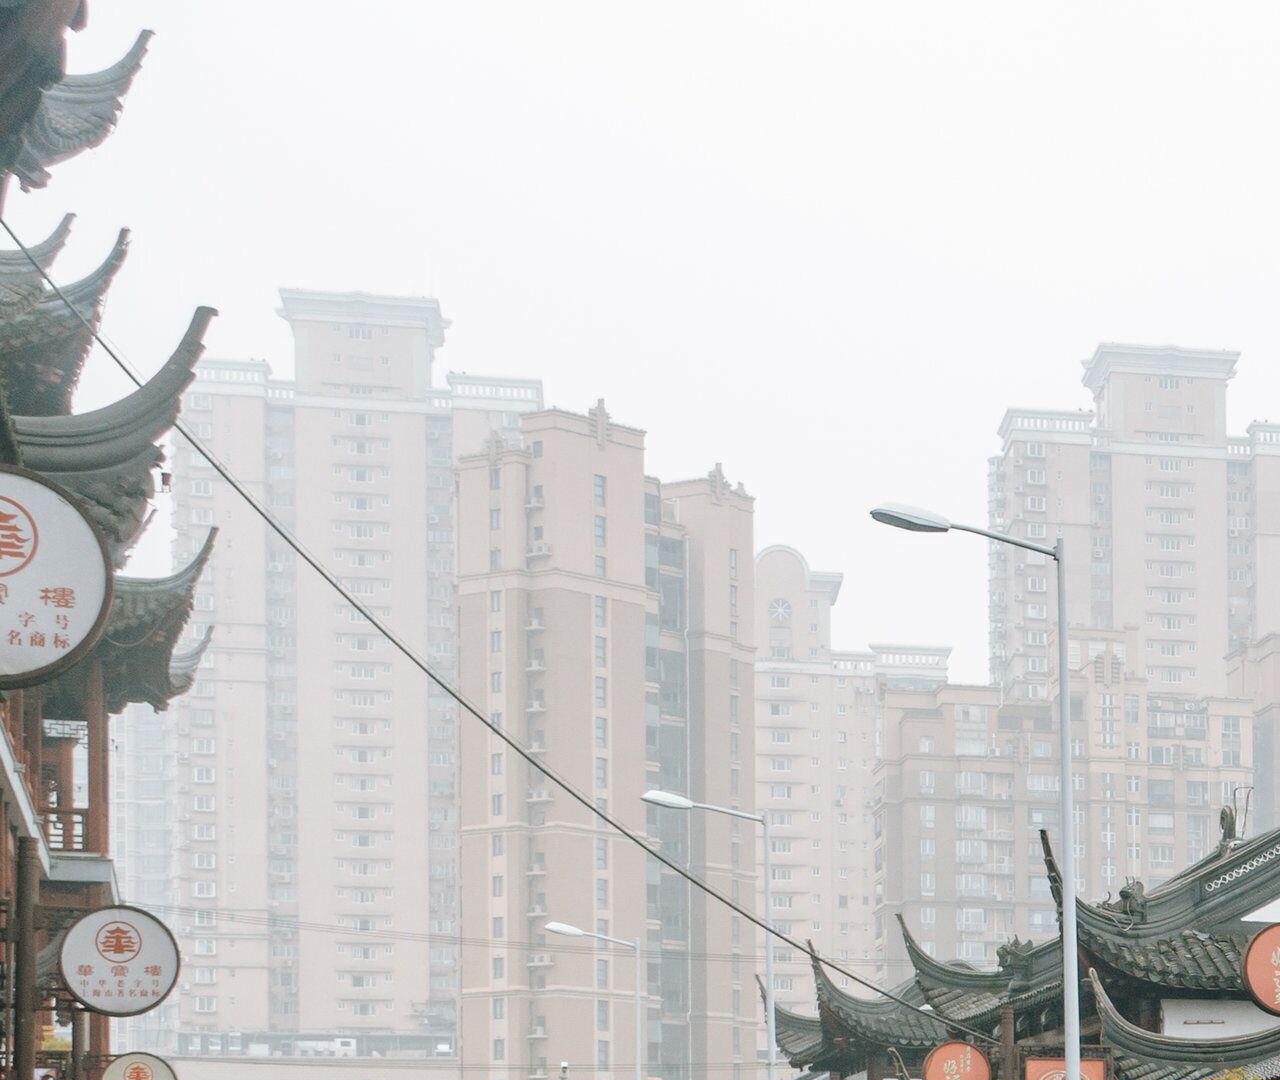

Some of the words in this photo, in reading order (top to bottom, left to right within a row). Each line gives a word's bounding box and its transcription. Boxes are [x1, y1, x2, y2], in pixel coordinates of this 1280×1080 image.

[18, 612, 70, 631] 字号
[8, 630, 71, 650] 名商标
